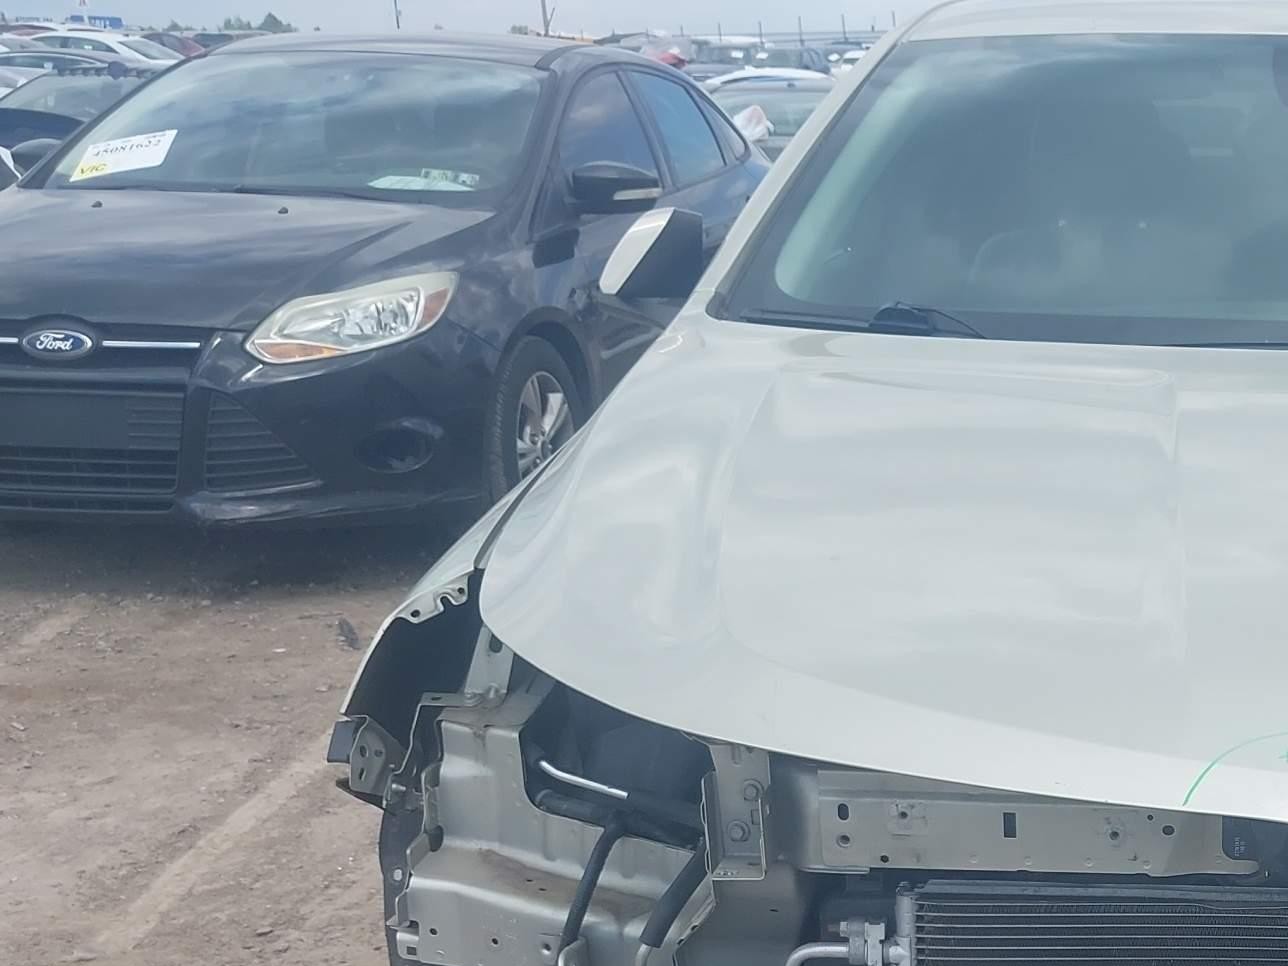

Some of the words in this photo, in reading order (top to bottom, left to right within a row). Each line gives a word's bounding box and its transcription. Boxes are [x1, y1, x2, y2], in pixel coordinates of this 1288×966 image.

[93, 139, 162, 157] 45081622
[80, 162, 107, 175] VIC
[35, 333, 74, 350] Ford
